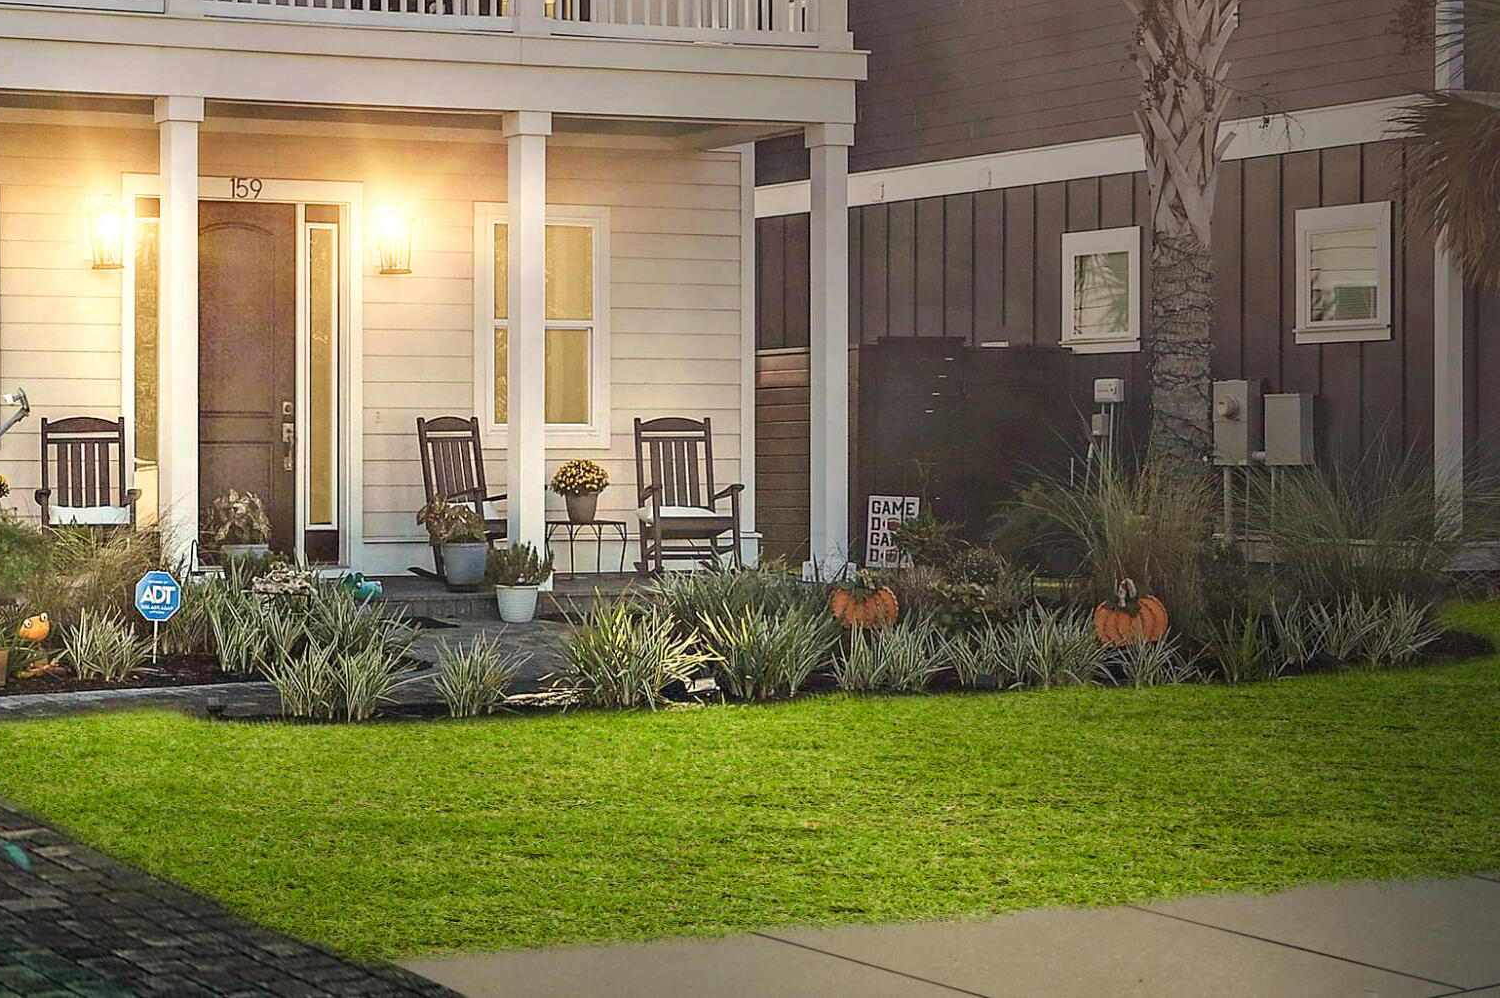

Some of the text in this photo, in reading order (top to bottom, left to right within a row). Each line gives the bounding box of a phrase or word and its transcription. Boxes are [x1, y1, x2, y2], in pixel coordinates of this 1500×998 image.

[230, 177, 263, 200] 159
[872, 500, 916, 516] GAME
[140, 585, 176, 604] ADT
